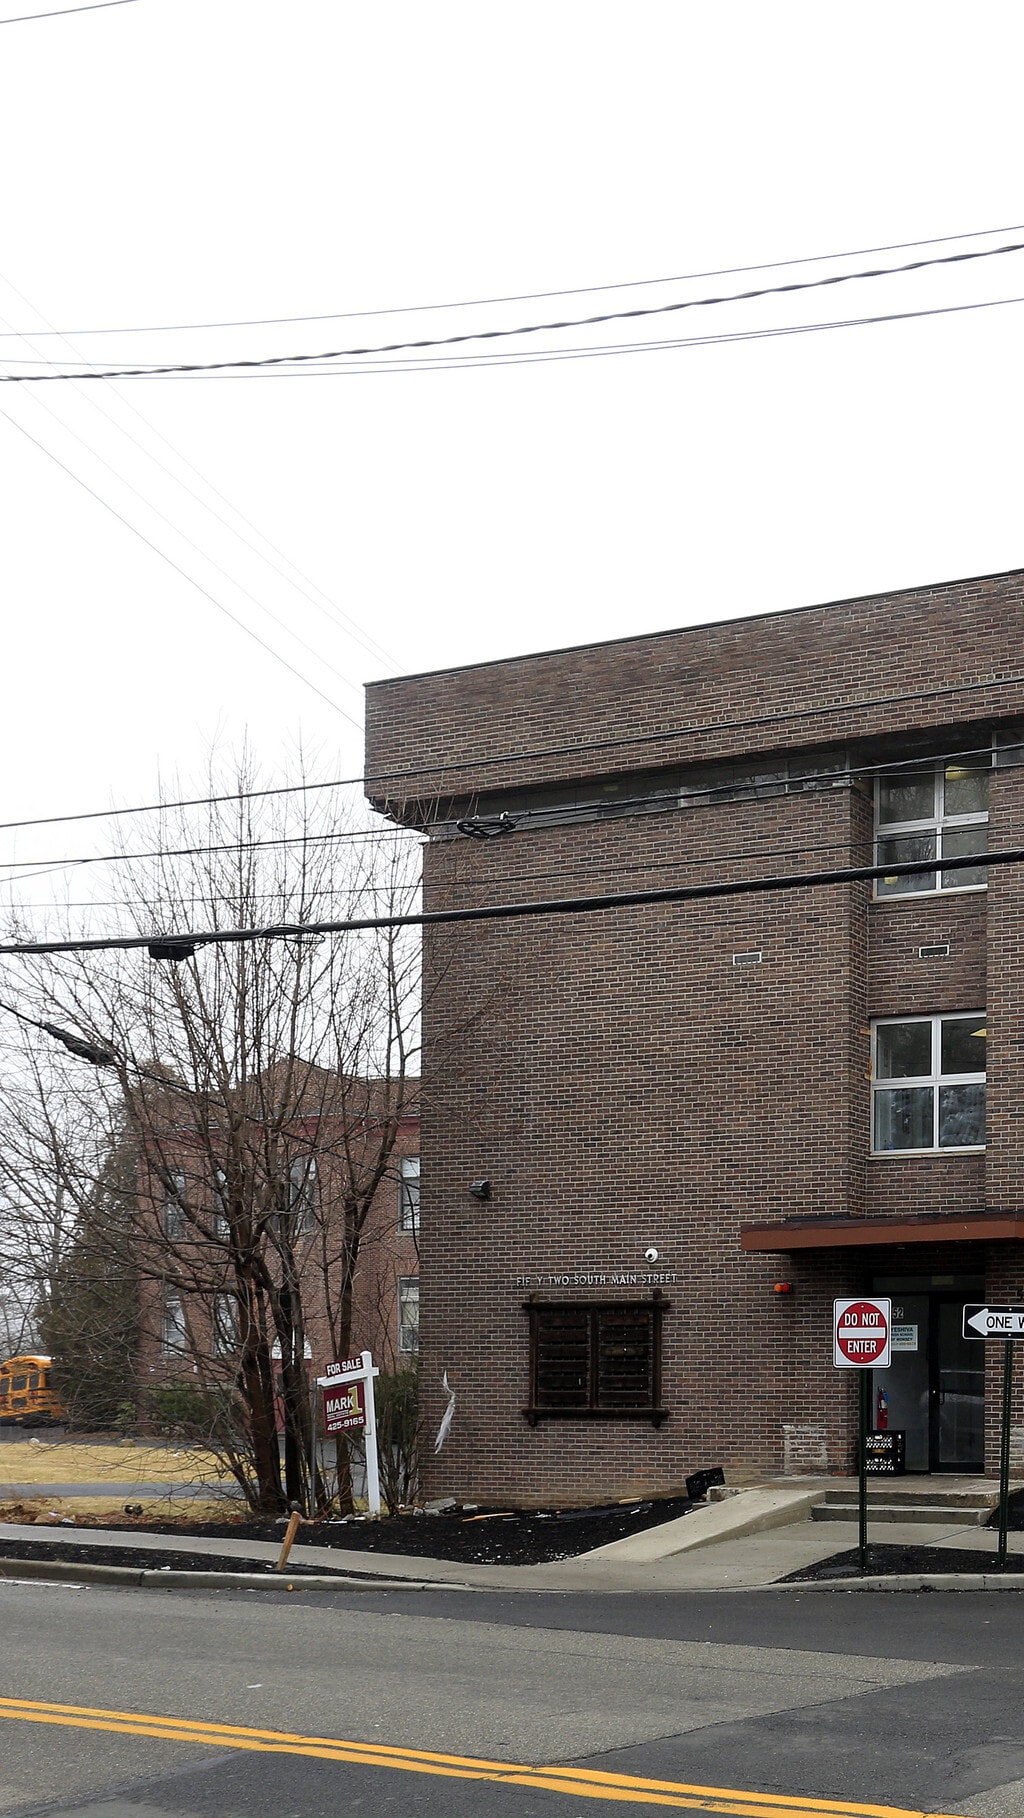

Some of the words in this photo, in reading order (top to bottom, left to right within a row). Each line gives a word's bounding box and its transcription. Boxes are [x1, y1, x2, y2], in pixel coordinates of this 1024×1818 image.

[548, 1276, 569, 1286] TWO
[574, 1275, 606, 1285] SOUTH
[611, 1274, 637, 1285] MAIN
[642, 1273, 678, 1284] STREET
[844, 1313, 858, 1326] DO
[862, 1313, 880, 1326] NOT
[892, 1307, 903, 1319] 52
[986, 1316, 1013, 1329] ONE
[847, 1340, 877, 1353] ENTER
[326, 1363, 341, 1376] FOR
[342, 1358, 362, 1372] SALE
[327, 1416, 364, 1431] 425-9165
